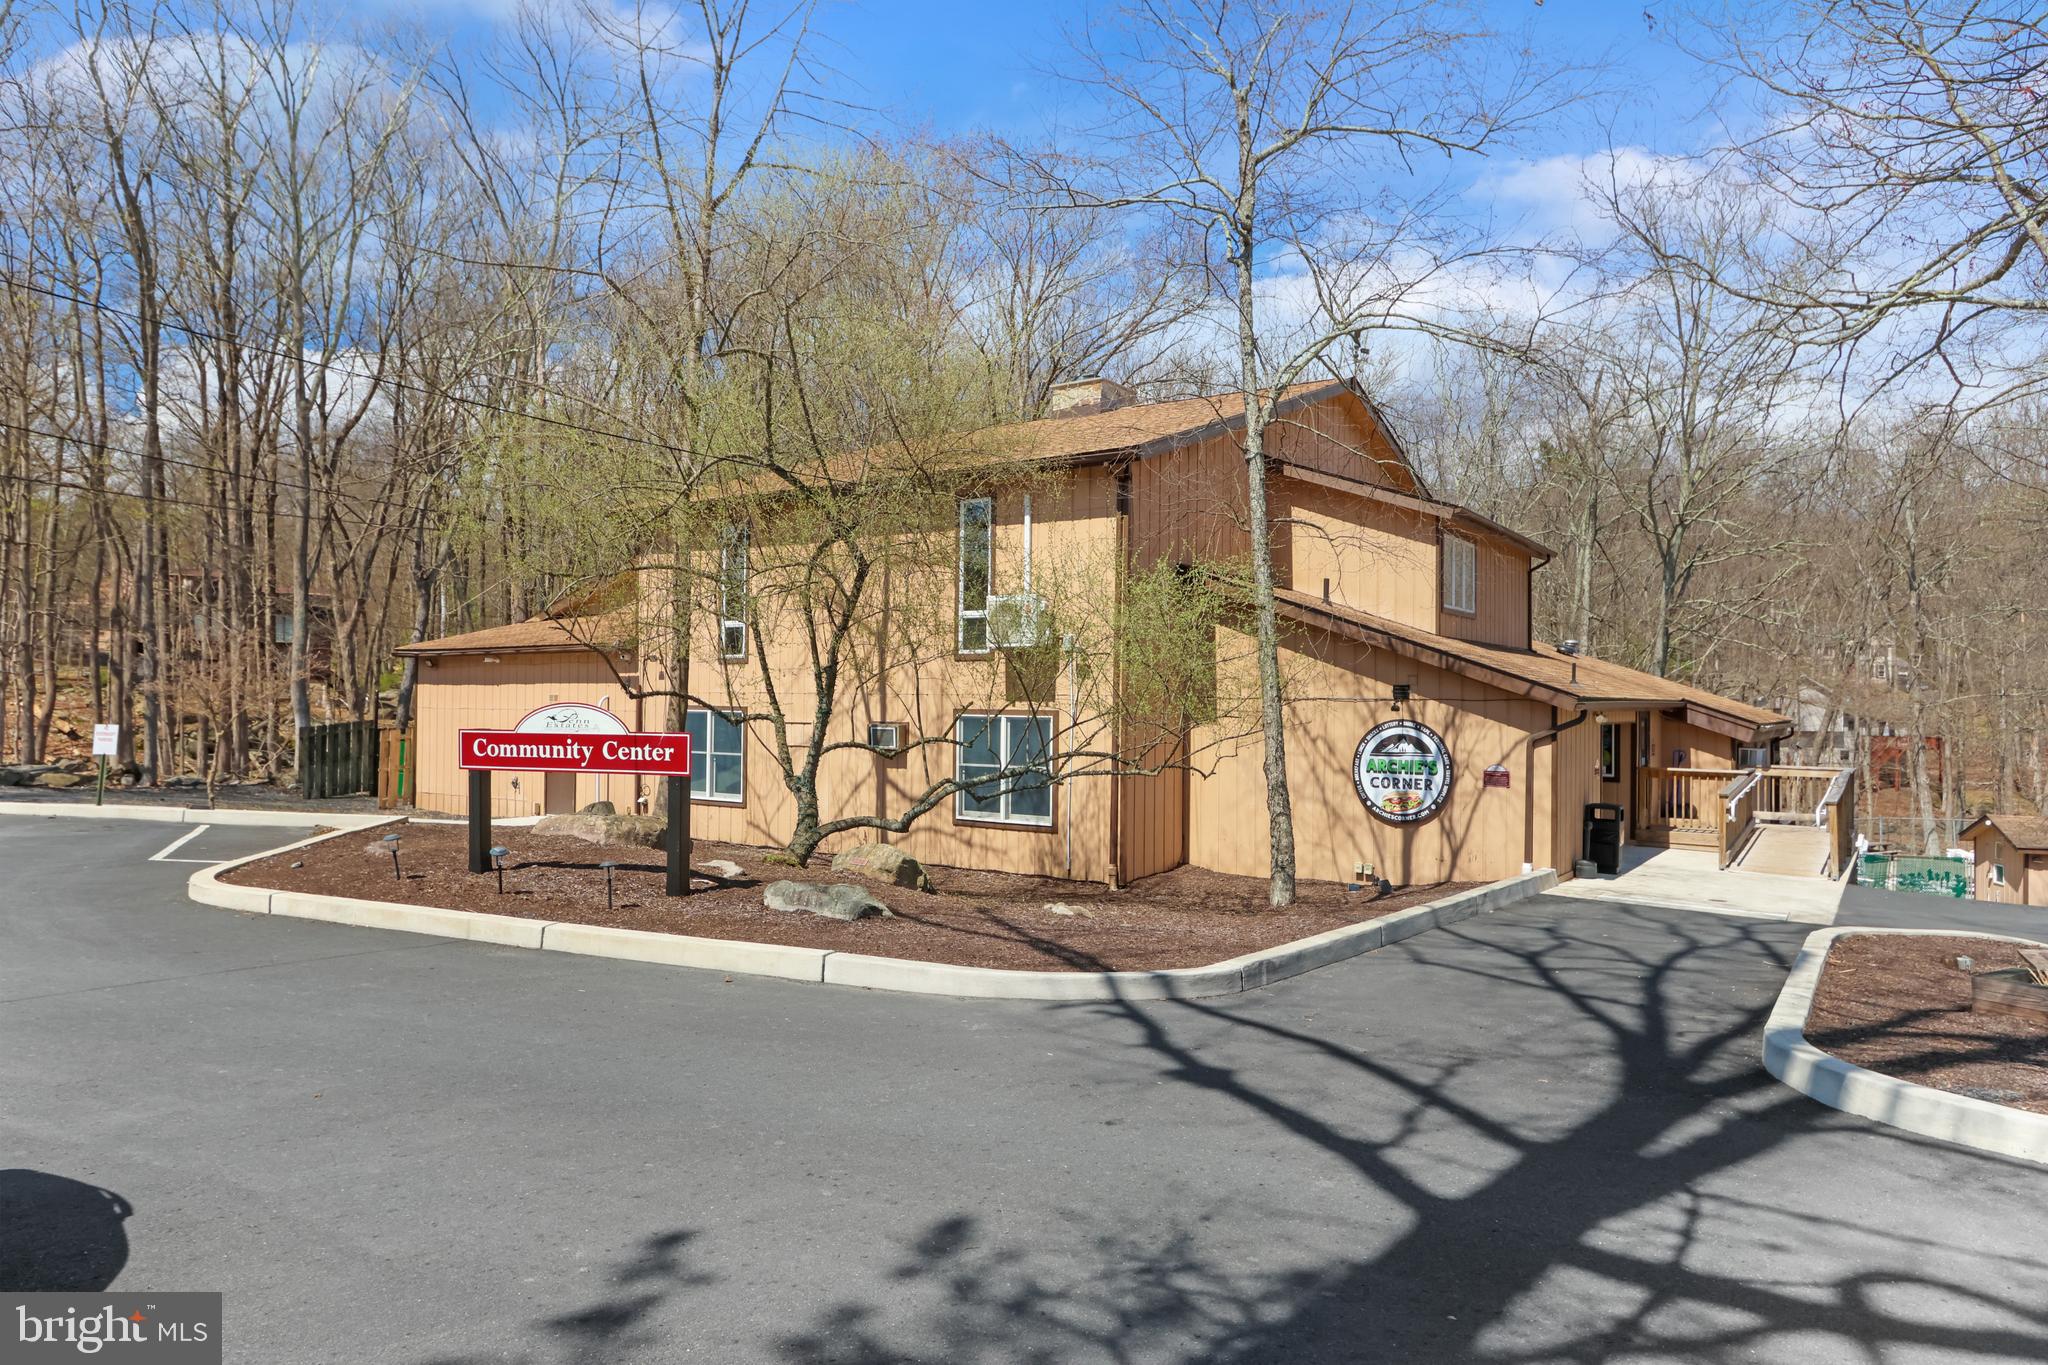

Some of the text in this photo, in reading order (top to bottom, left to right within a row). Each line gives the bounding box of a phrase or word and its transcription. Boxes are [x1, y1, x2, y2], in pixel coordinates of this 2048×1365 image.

[472, 738, 675, 767] Community Center
[1366, 758, 1438, 777] ARCHIE'S
[1370, 777, 1433, 791] CORNER
